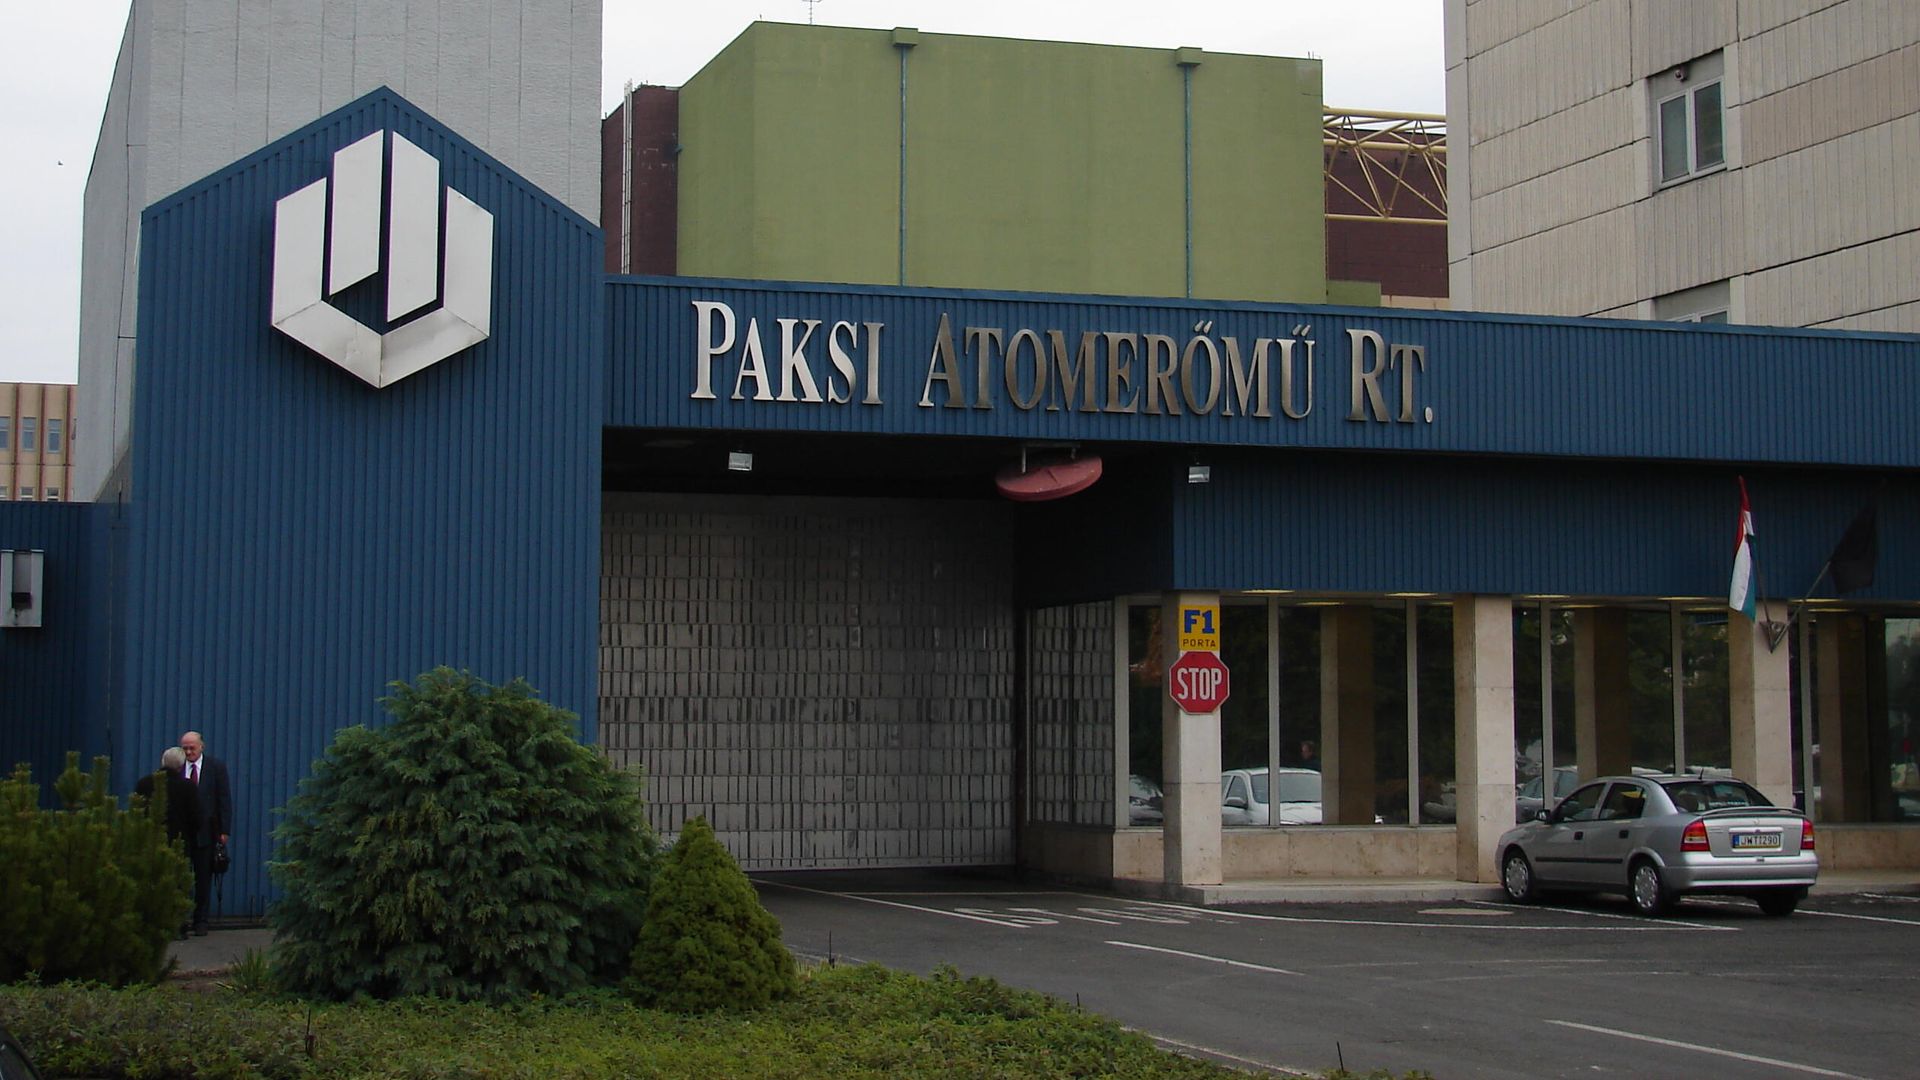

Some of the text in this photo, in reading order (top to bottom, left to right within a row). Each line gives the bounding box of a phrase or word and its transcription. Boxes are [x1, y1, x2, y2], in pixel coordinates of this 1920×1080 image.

[691, 301, 1433, 423] PAKSI ATOMERŐMŰ RT.
[1184, 610, 1215, 634] F1
[1183, 639, 1216, 647] PORTA
[1177, 667, 1222, 700] STOP
